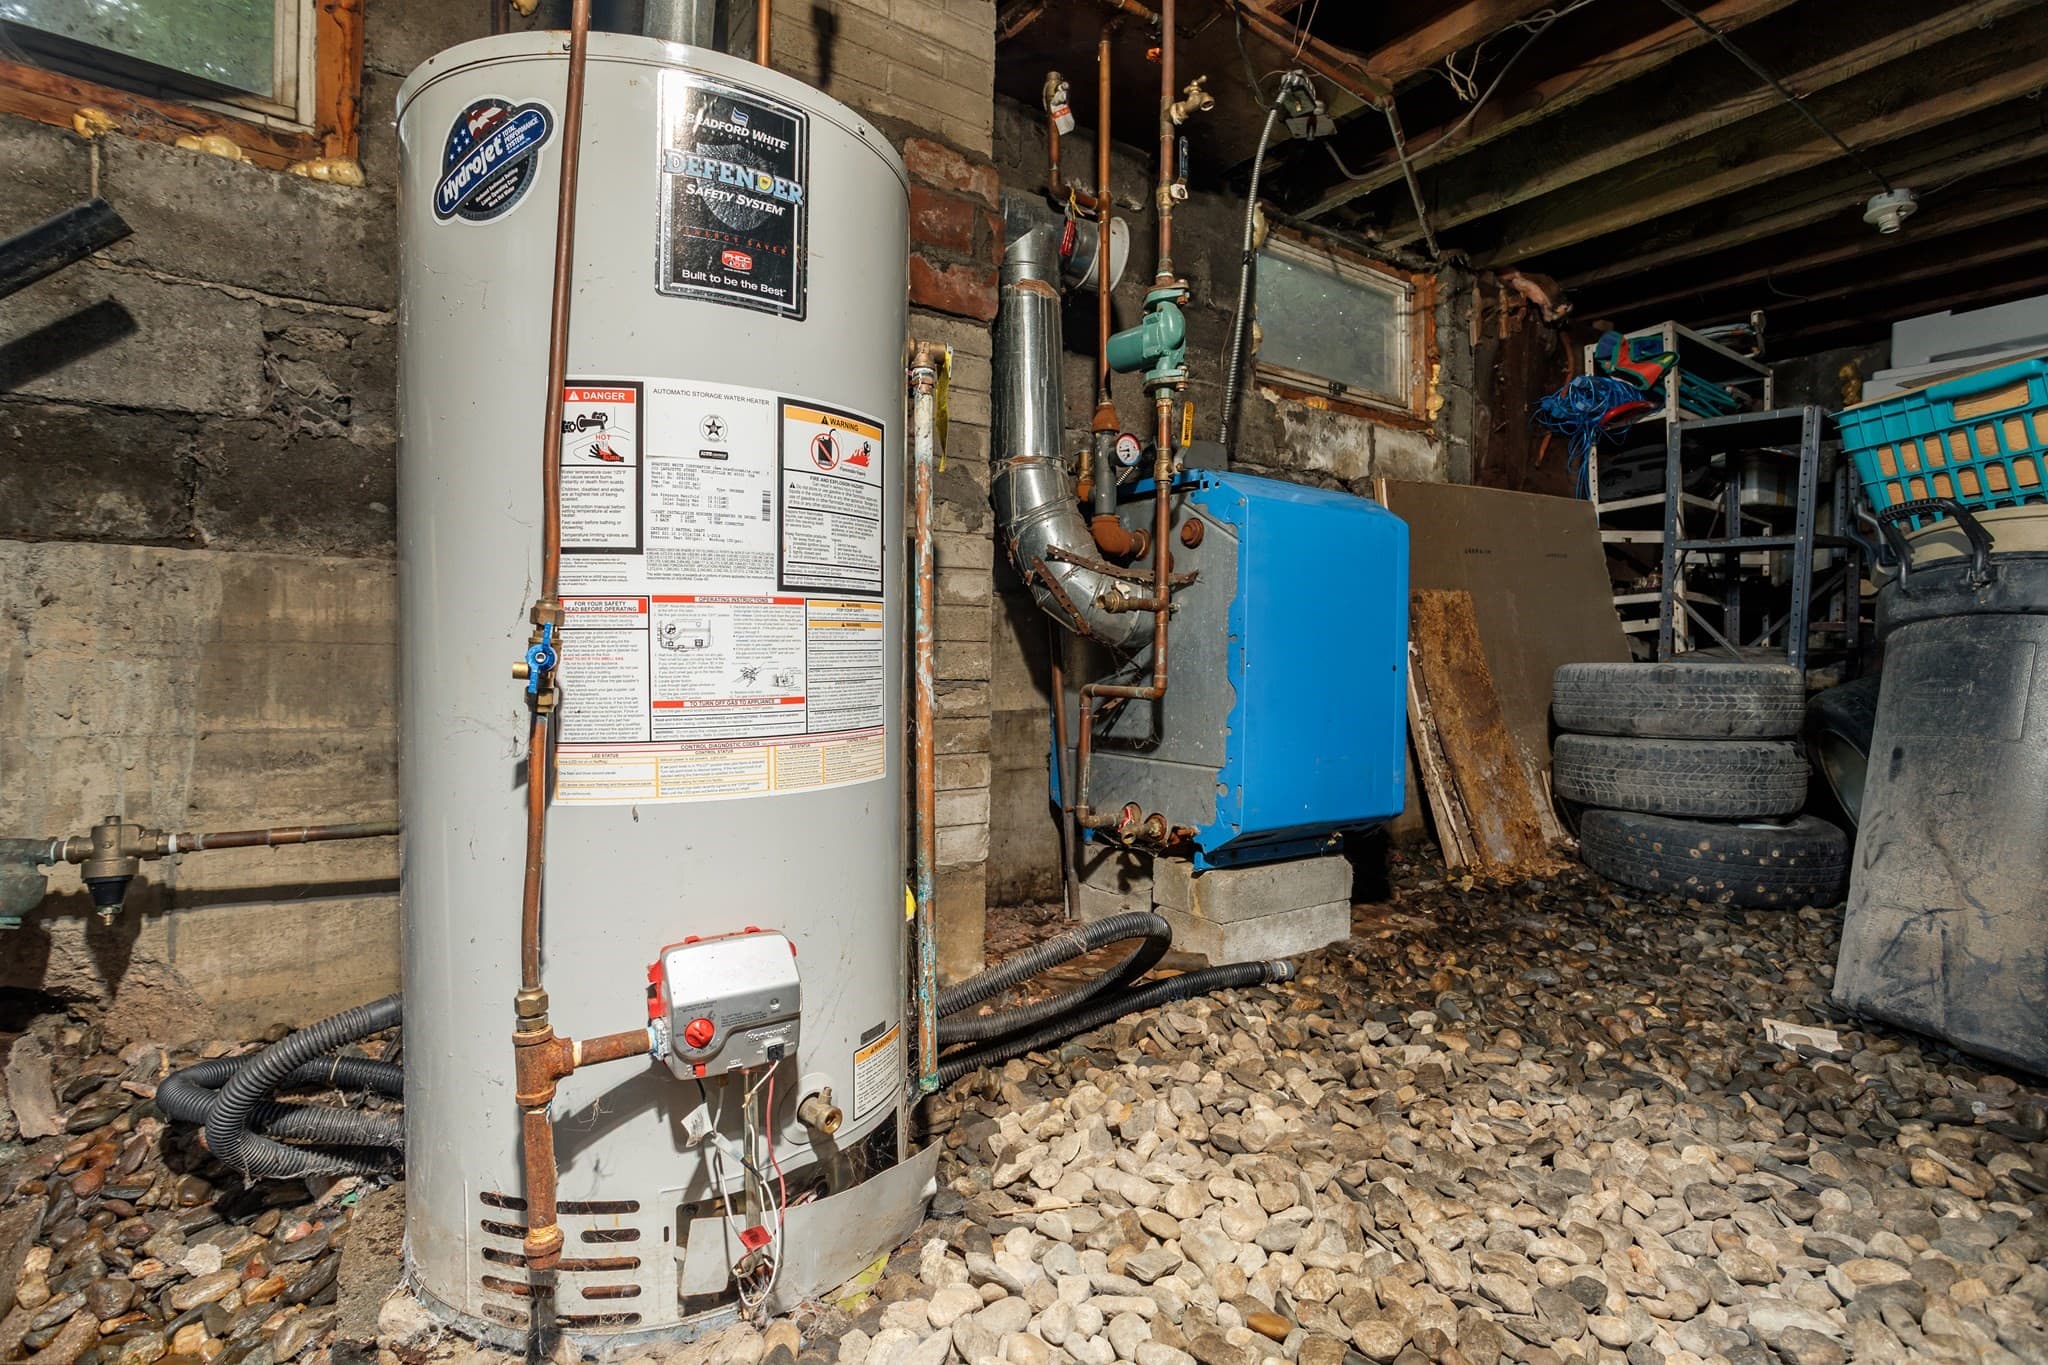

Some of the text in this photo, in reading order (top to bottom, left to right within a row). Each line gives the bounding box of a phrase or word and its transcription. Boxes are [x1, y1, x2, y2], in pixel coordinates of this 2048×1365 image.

[502, 124, 517, 137] TOTAL
[504, 117, 538, 144] PERFORMANCE
[753, 129, 788, 150] WHITE
[505, 134, 525, 150] SYSTEM
[443, 138, 503, 205] Hydrojet
[664, 149, 804, 206] DEFENDER
[686, 183, 785, 216] SAFETY SYSTEM
[684, 226, 788, 255] ENERGY SAVER
[724, 253, 751, 263] PHCC
[682, 269, 785, 297] Built to be the Best
[583, 392, 625, 400] DANGER
[653, 388, 770, 406] AUTOMATIC STORAGE WATER HEATER
[830, 418, 859, 432] WARNING
